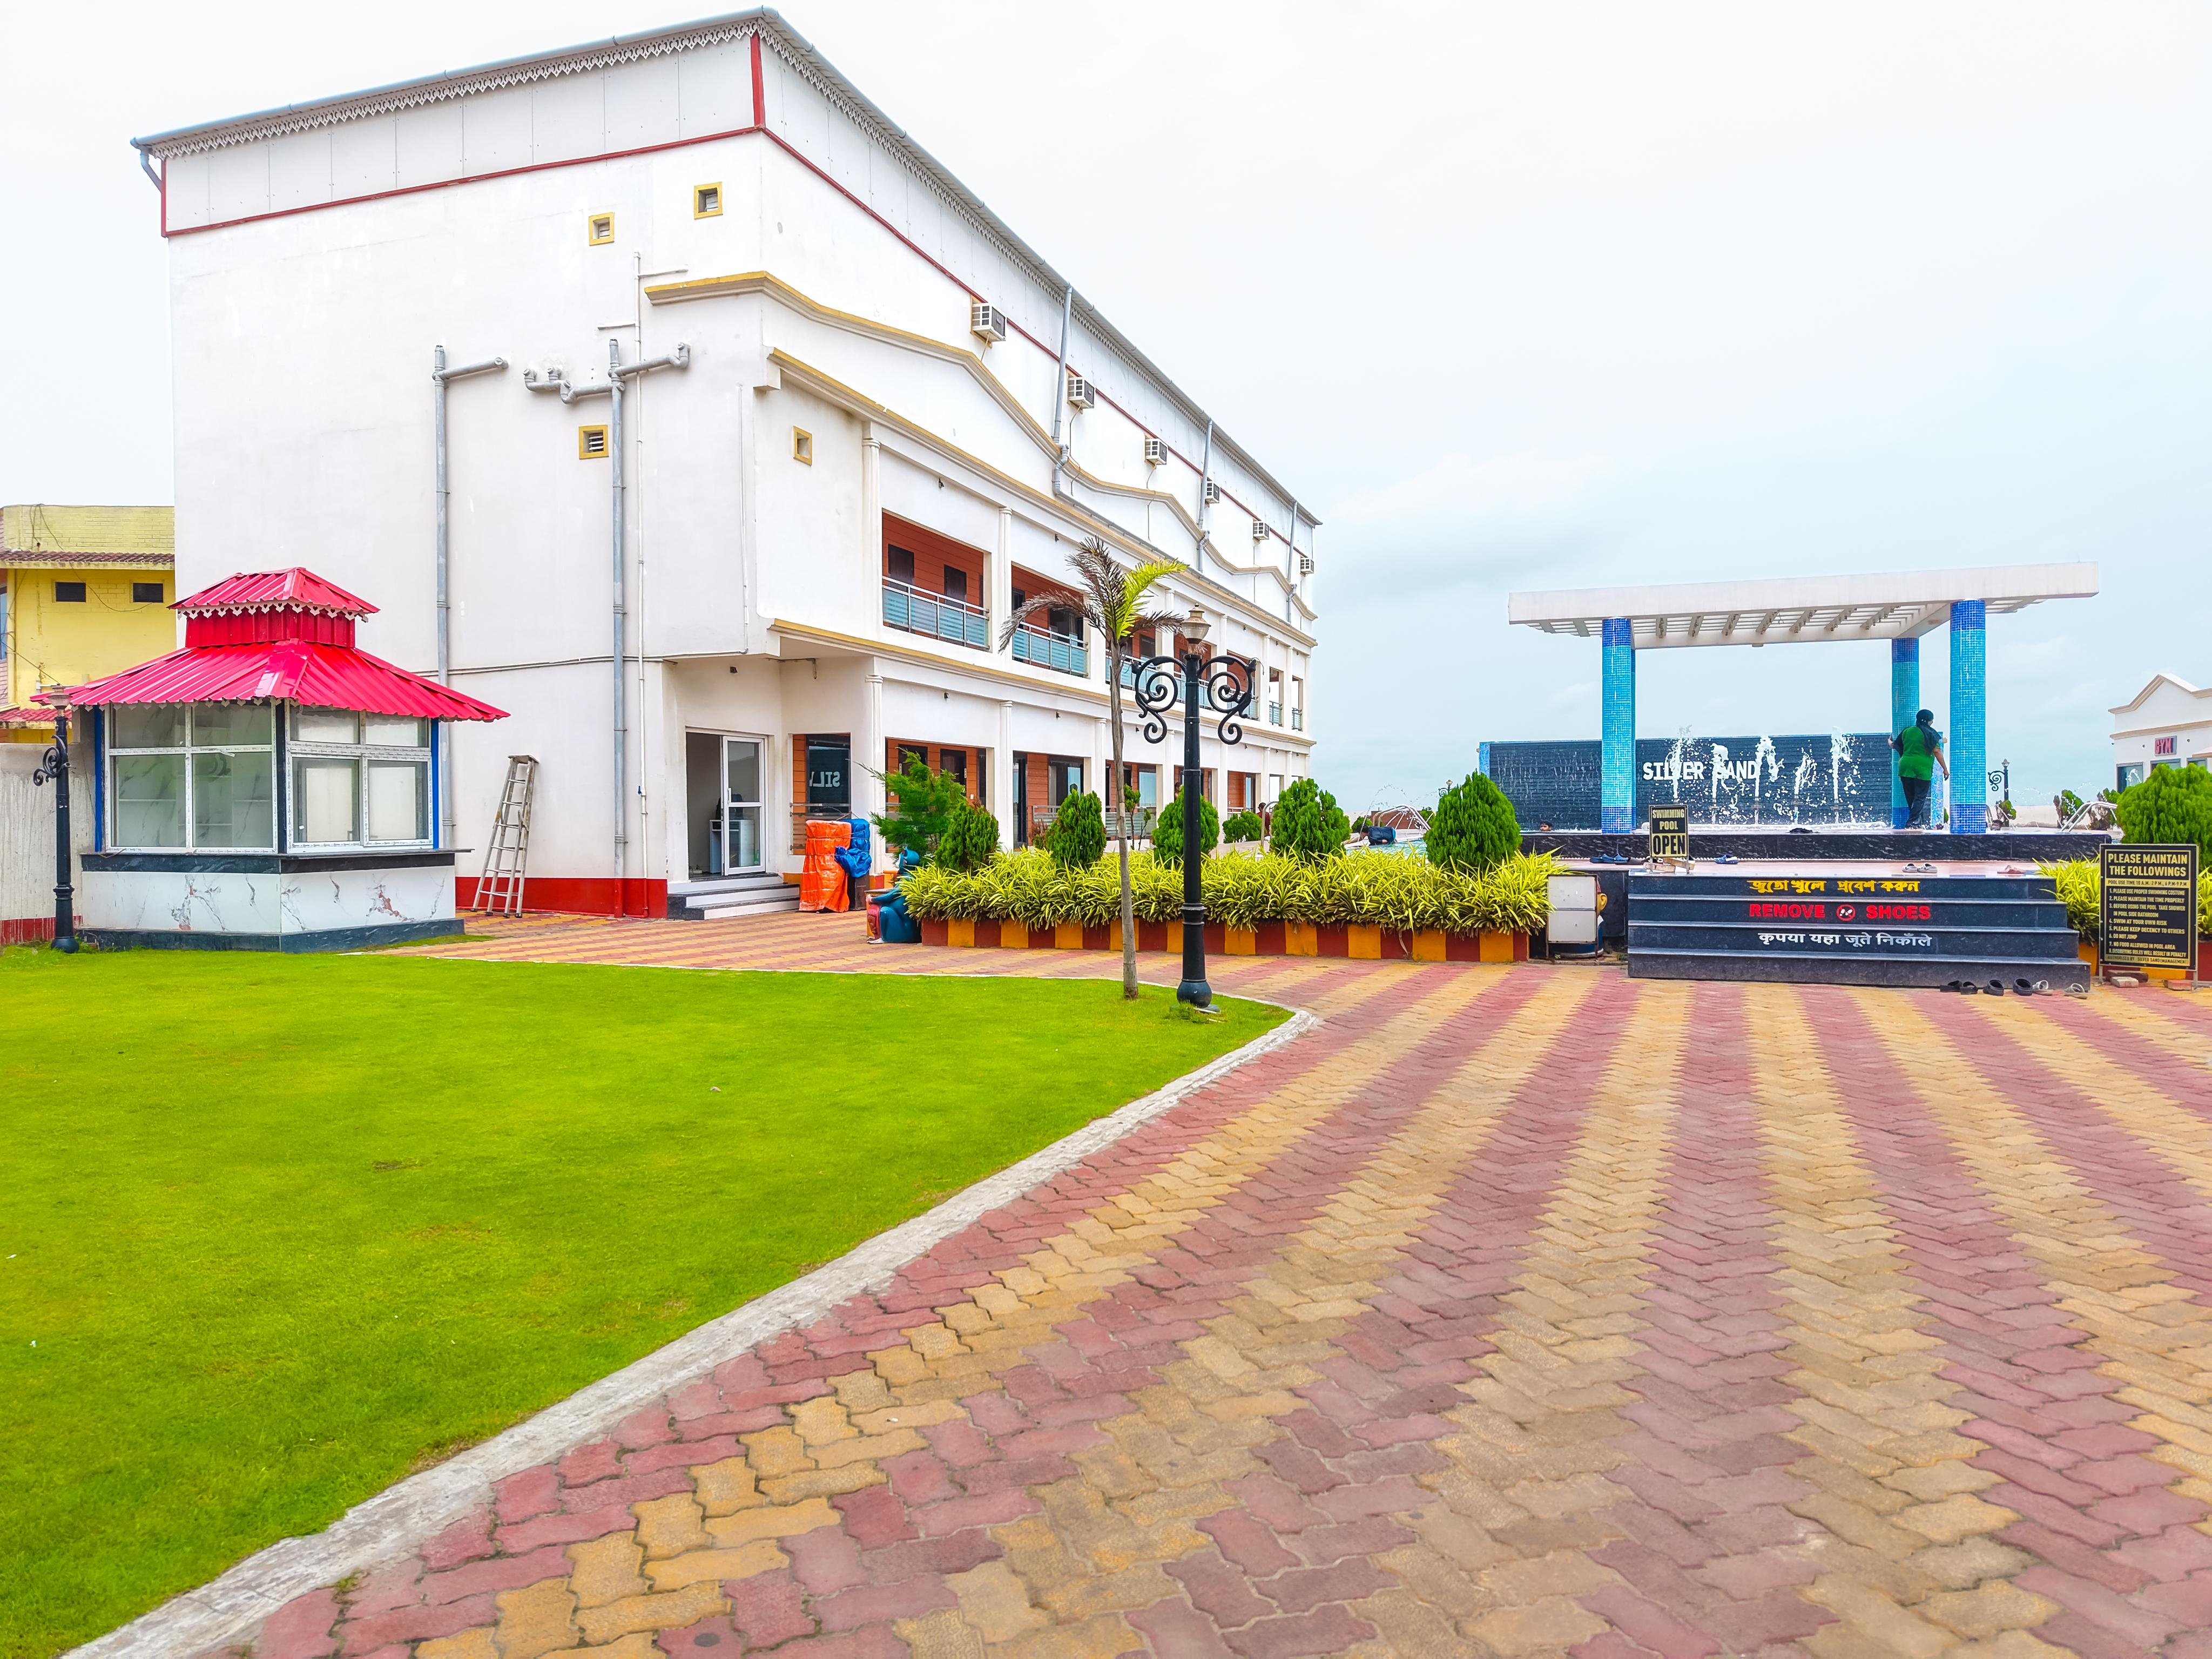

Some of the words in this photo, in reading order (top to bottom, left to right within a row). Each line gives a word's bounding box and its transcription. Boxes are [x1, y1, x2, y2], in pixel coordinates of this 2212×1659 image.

[2155, 738, 2173, 754] GYM
[1643, 761, 1704, 780] SILER
[1653, 809, 1684, 818] SWIMMING
[1660, 821, 1678, 830] POOL
[1653, 835, 1685, 855] OPEN
[2108, 853, 2141, 864] PLEASE
[2143, 854, 2187, 864] MAINTAIN
[2109, 866, 2126, 875] THE
[2127, 866, 2187, 877] FOLLOWINGS
[1746, 880, 1789, 893] জুতো
[1791, 880, 1827, 893] খুলে
[1837, 880, 1877, 893] প্রবেশ
[1749, 904, 1825, 918] REMOVE
[1866, 906, 1931, 920] SHOES
[1758, 933, 1805, 945] कृपया
[1844, 932, 1872, 947] जूते
